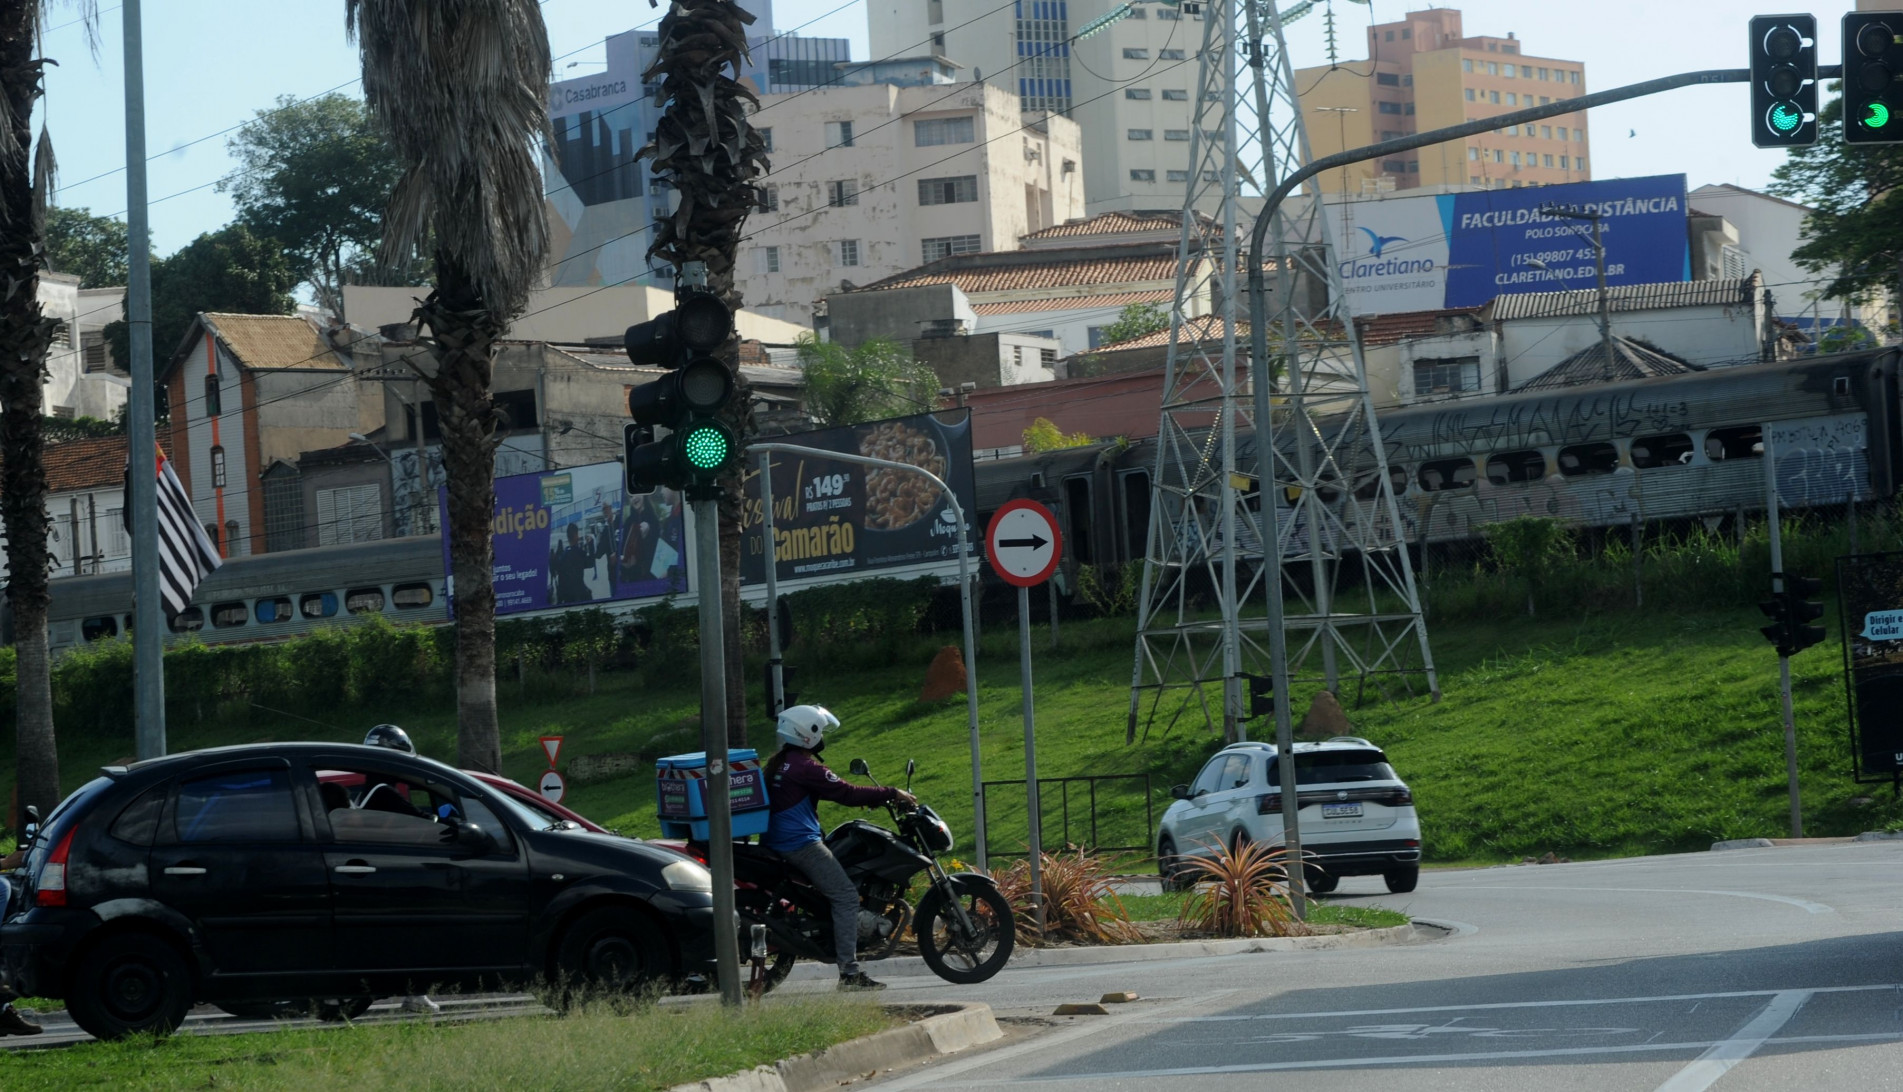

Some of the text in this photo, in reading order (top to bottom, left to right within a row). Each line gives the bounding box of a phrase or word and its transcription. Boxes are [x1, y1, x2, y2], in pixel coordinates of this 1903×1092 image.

[565, 81, 627, 104] Casabranca
[1584, 197, 1678, 217] DISTÂNCIA
[1525, 227, 1553, 239] POLO
[1340, 257, 1434, 279] Claretiano
[1511, 253, 1533, 267] (15)
[1537, 249, 1574, 263] 99807
[1495, 264, 1625, 285] CLARETIANO.ED.BR
[1342, 285, 1373, 295] ENTRO
[813, 474, 844, 497] 149
[493, 504, 549, 540] dição
[1870, 615, 1896, 626] Dirigir
[1871, 625, 1899, 636] Celular
